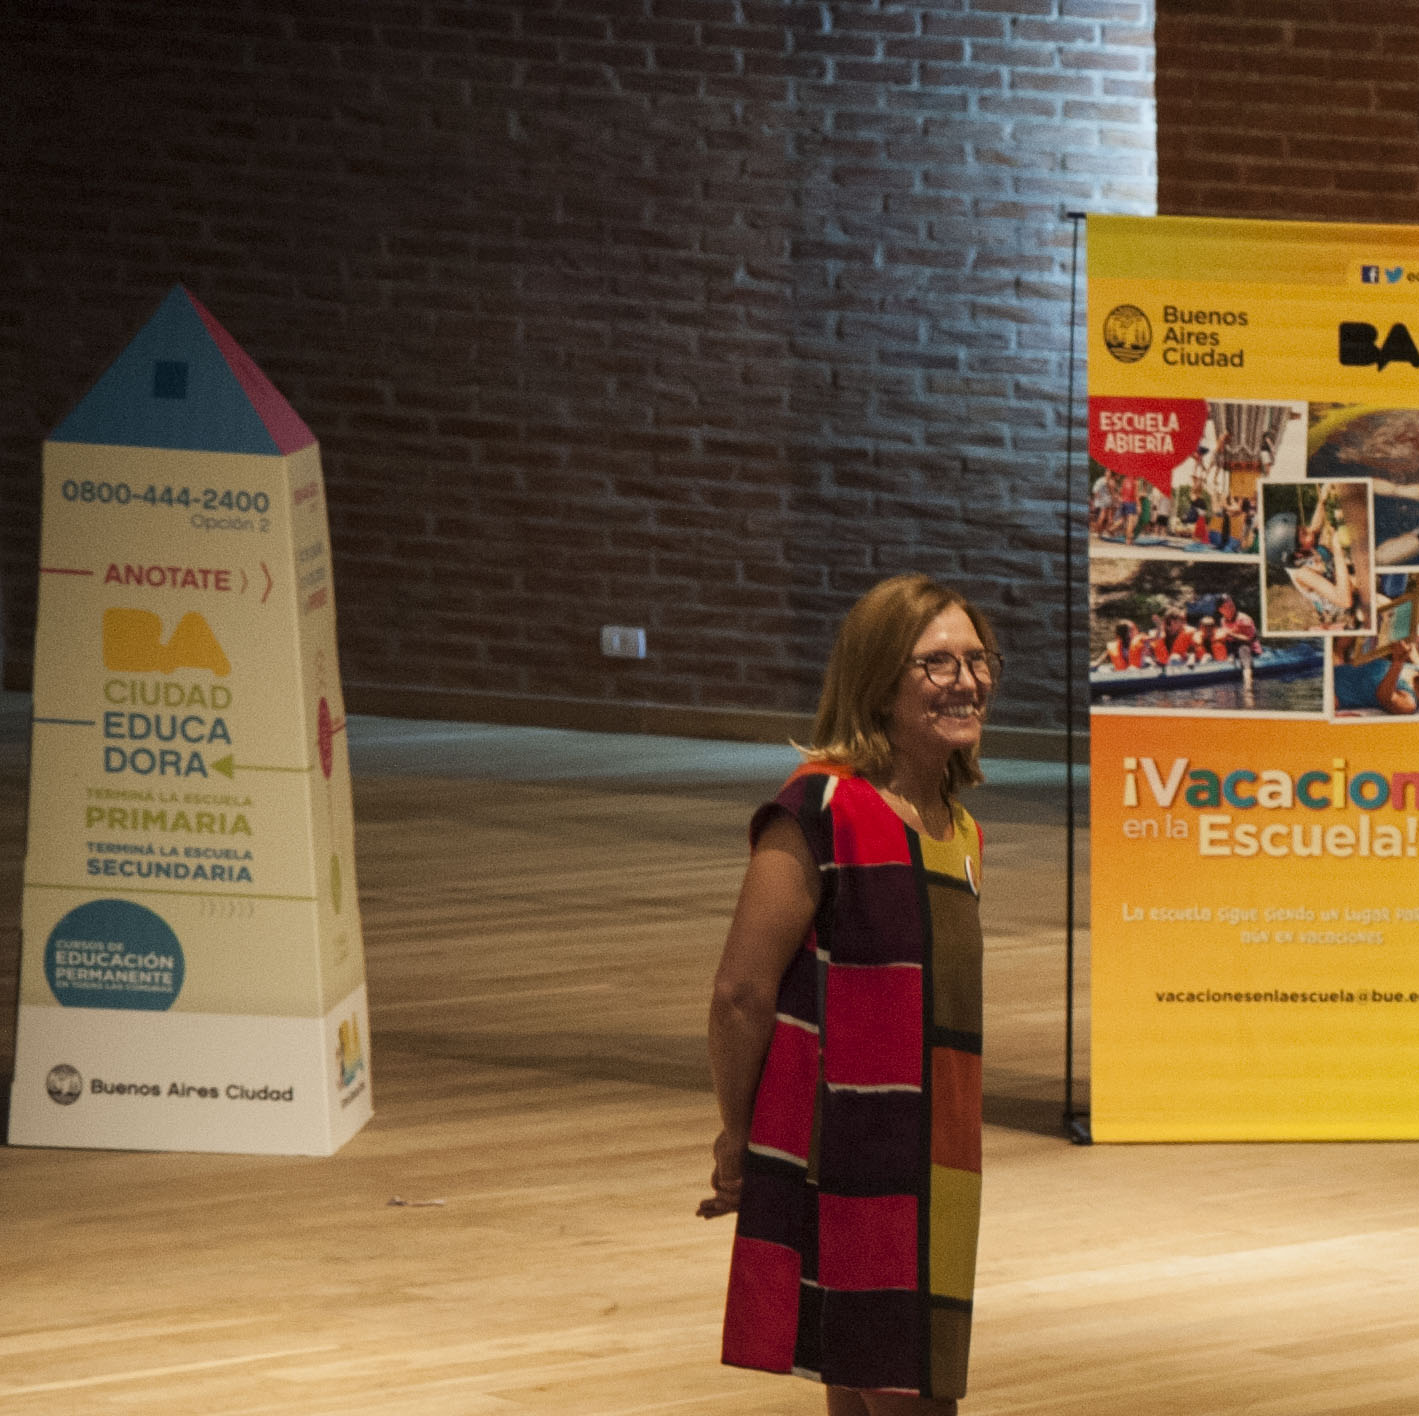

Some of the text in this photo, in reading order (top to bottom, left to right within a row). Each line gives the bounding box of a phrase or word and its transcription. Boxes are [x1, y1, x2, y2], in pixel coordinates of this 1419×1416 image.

[1163, 305, 1249, 326] Buenos
[1163, 328, 1220, 347] Aires
[1163, 348, 1245, 368] Ciudad
[1104, 431, 1175, 455] ABIERTA
[62, 480, 270, 513] 0800-444-2400
[259, 518, 271, 532] 2
[104, 563, 233, 591] ANOTATE
[103, 608, 231, 677] BA
[103, 679, 233, 710] CIUDAD
[103, 711, 233, 744] EDUCA
[104, 746, 209, 778] DORA
[85, 805, 252, 836] PRIMARIA
[1123, 815, 1419, 857] en la Escuela!
[160, 845, 179, 857] LA
[184, 847, 254, 861] ESCUELA
[87, 858, 253, 882] SECUNDARIA
[55, 950, 174, 969] EDUCACIÓN
[55, 967, 173, 985] PERMANENTE
[90, 1079, 293, 1102] Buenos Aires Ciudad
